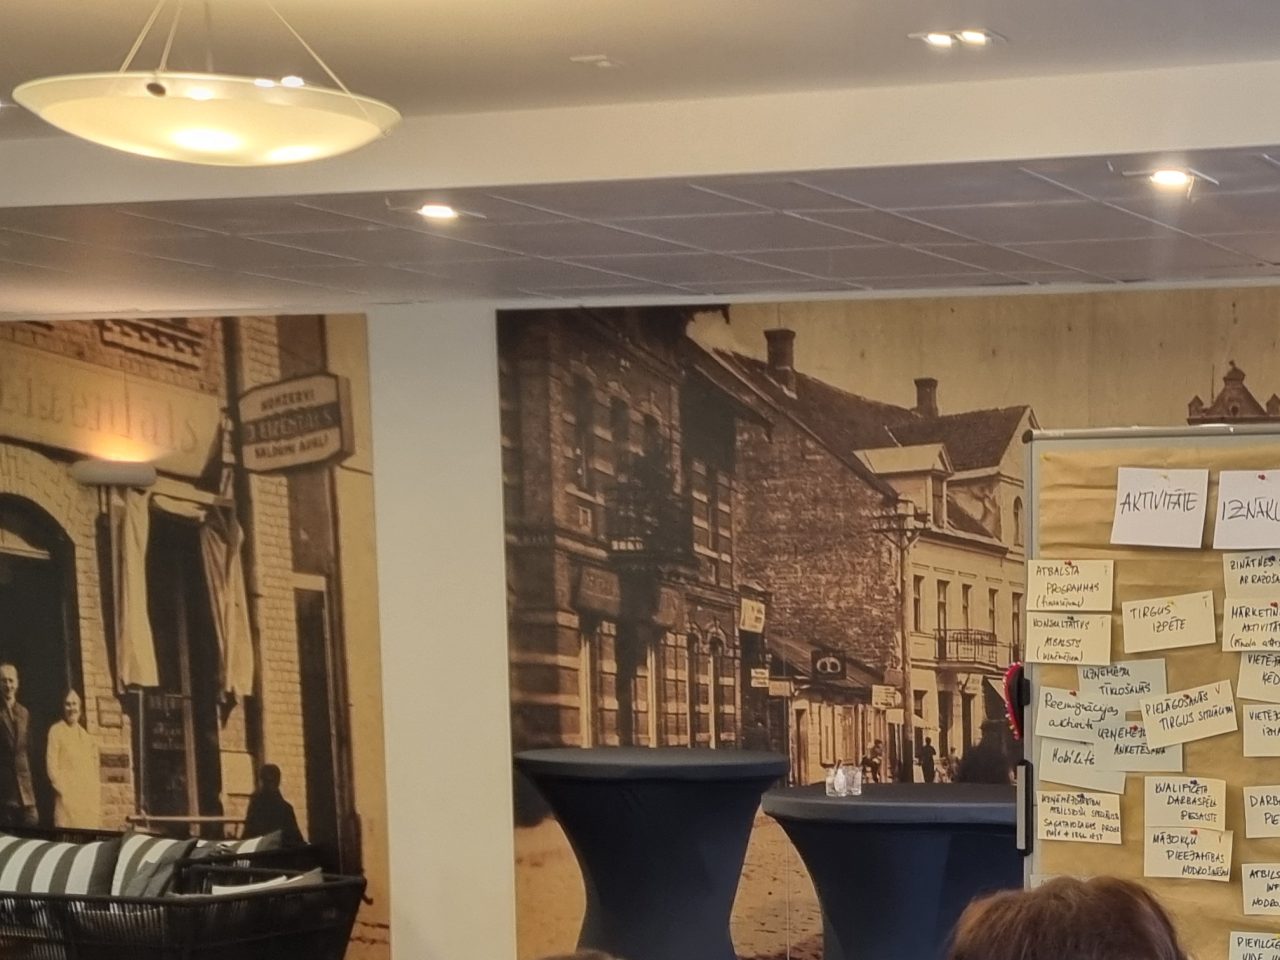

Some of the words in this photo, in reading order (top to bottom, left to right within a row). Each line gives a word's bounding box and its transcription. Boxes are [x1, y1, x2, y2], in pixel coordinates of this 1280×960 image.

[1120, 488, 1199, 514] AKTIVITĀTE
[1046, 582, 1100, 595] PROGRAMMAS
[1130, 605, 1171, 619] TIRGUS
[1152, 616, 1186, 633] IZPĒTE
[1159, 712, 1195, 730] TIRGUS
